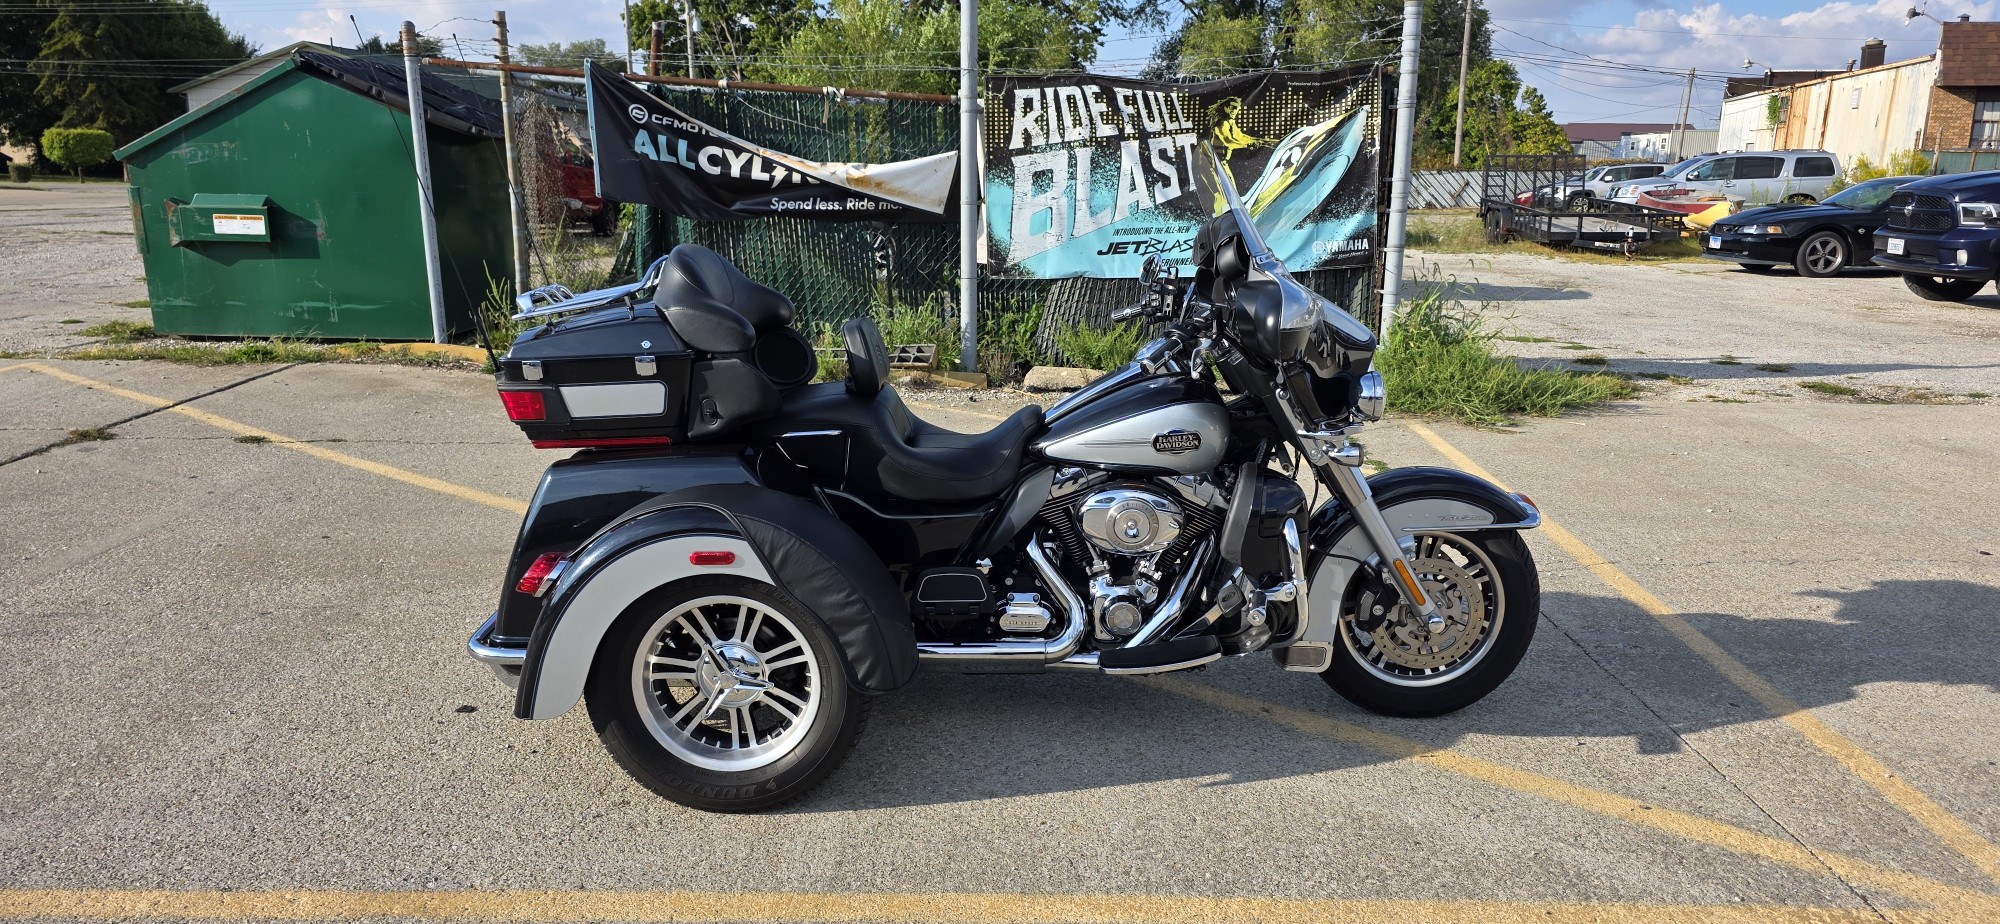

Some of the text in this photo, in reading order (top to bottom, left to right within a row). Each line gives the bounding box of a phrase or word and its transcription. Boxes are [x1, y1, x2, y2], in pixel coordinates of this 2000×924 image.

[1009, 85, 1193, 149] RIDE FULL
[770, 197, 814, 212] Spend
[815, 197, 843, 210] less.
[846, 197, 876, 210] Ride
[1005, 133, 1199, 266] BLAST
[1112, 225, 1192, 237] INTRODUCING THE ALL-NEW
[1097, 237, 1196, 257] JETBLAS
[1325, 238, 1370, 253] YAMAHA
[1156, 440, 1200, 449] DAVIDSON
